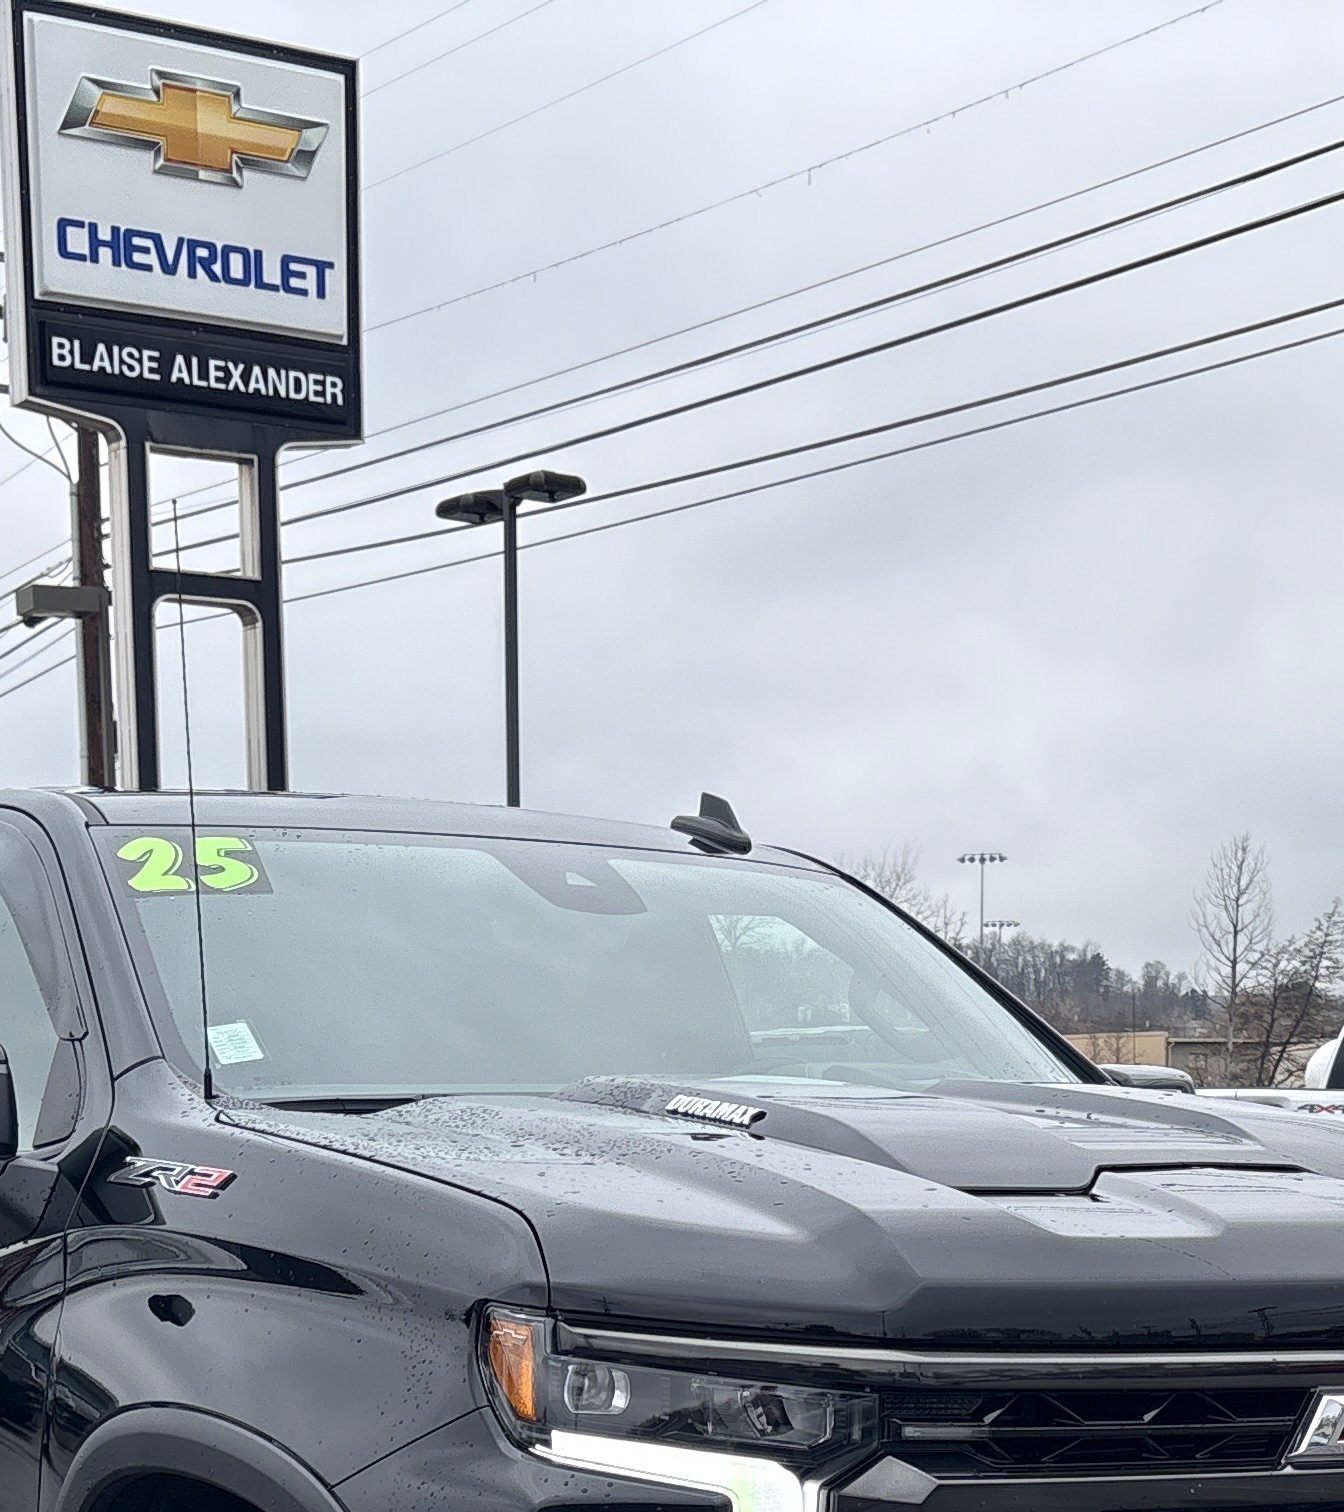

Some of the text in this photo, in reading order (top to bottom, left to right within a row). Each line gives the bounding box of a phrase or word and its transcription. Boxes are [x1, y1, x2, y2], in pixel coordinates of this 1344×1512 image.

[57, 217, 335, 299] CHEVROLET
[51, 336, 344, 405] BLAISE ALEXANDER
[117, 837, 259, 892] 25
[665, 1094, 762, 1125] DURAMAX
[106, 1155, 236, 1197] ZR2
